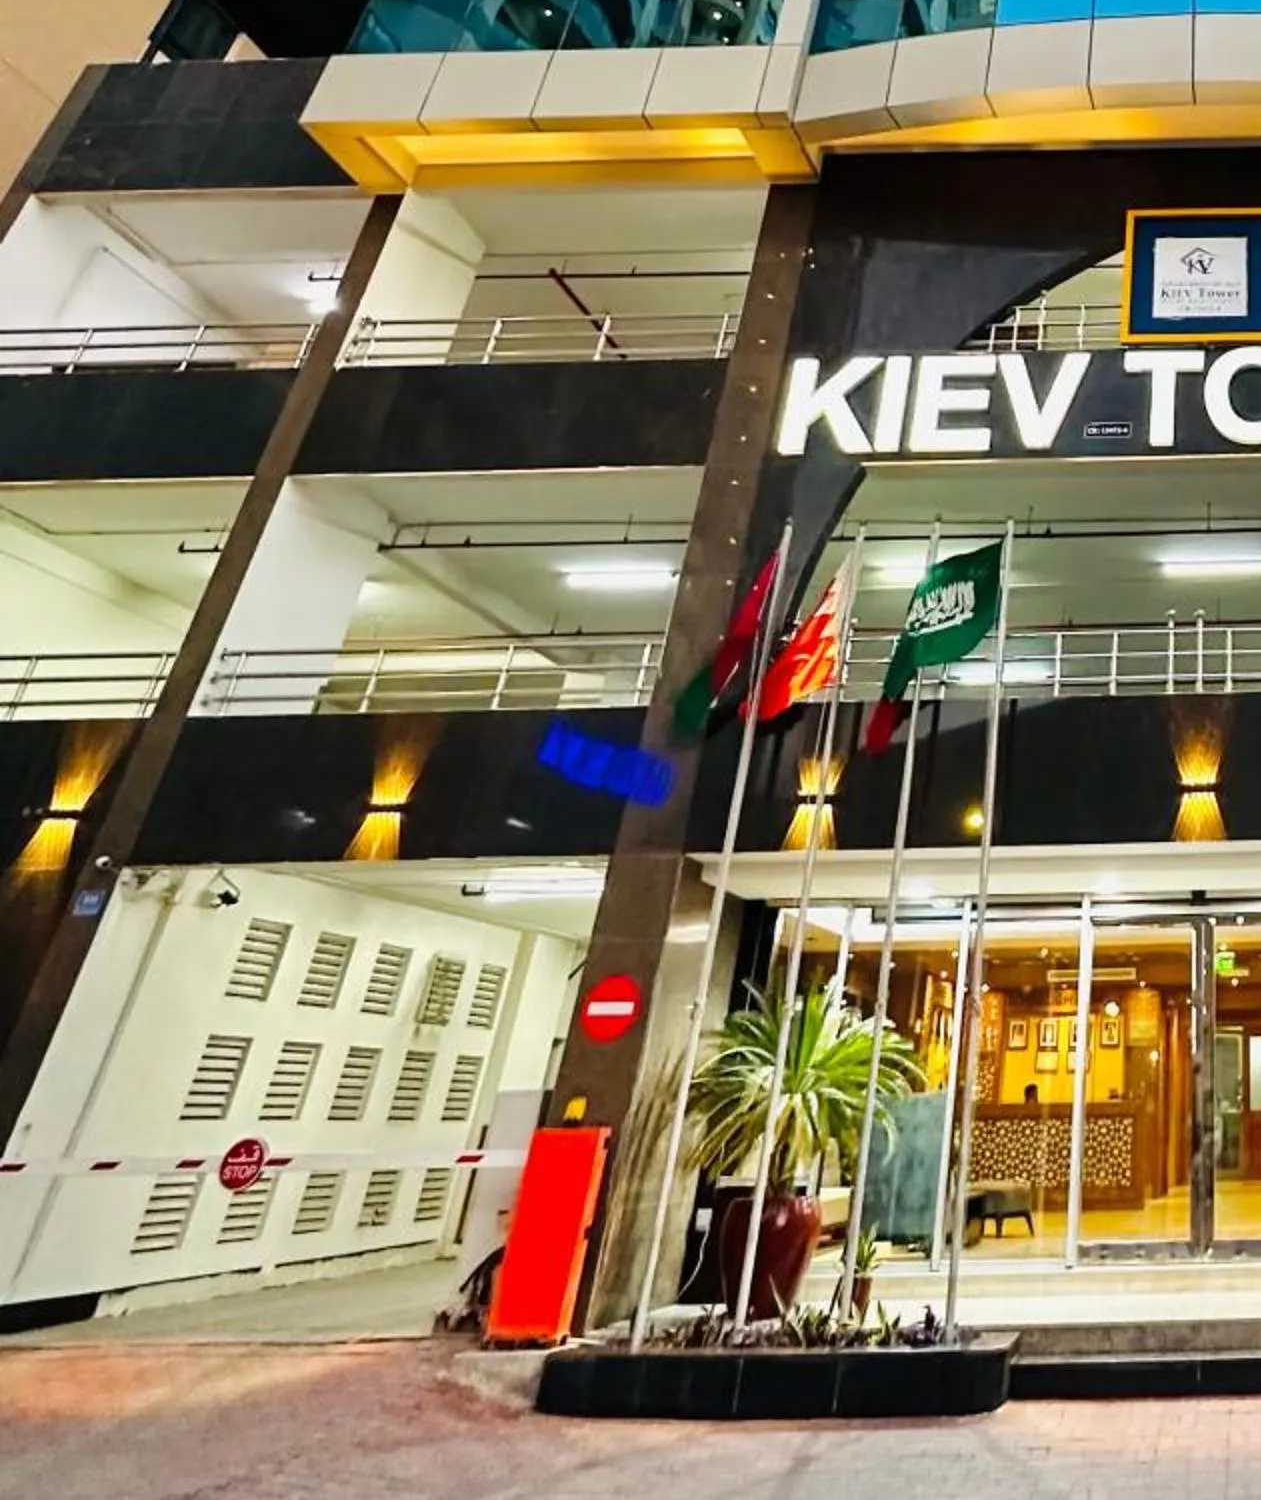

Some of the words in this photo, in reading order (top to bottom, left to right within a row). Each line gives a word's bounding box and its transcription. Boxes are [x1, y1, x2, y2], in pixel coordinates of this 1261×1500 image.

[776, 354, 1092, 456] KIEV
[227, 1145, 261, 1163] قف
[223, 1165, 258, 1180] STOP
